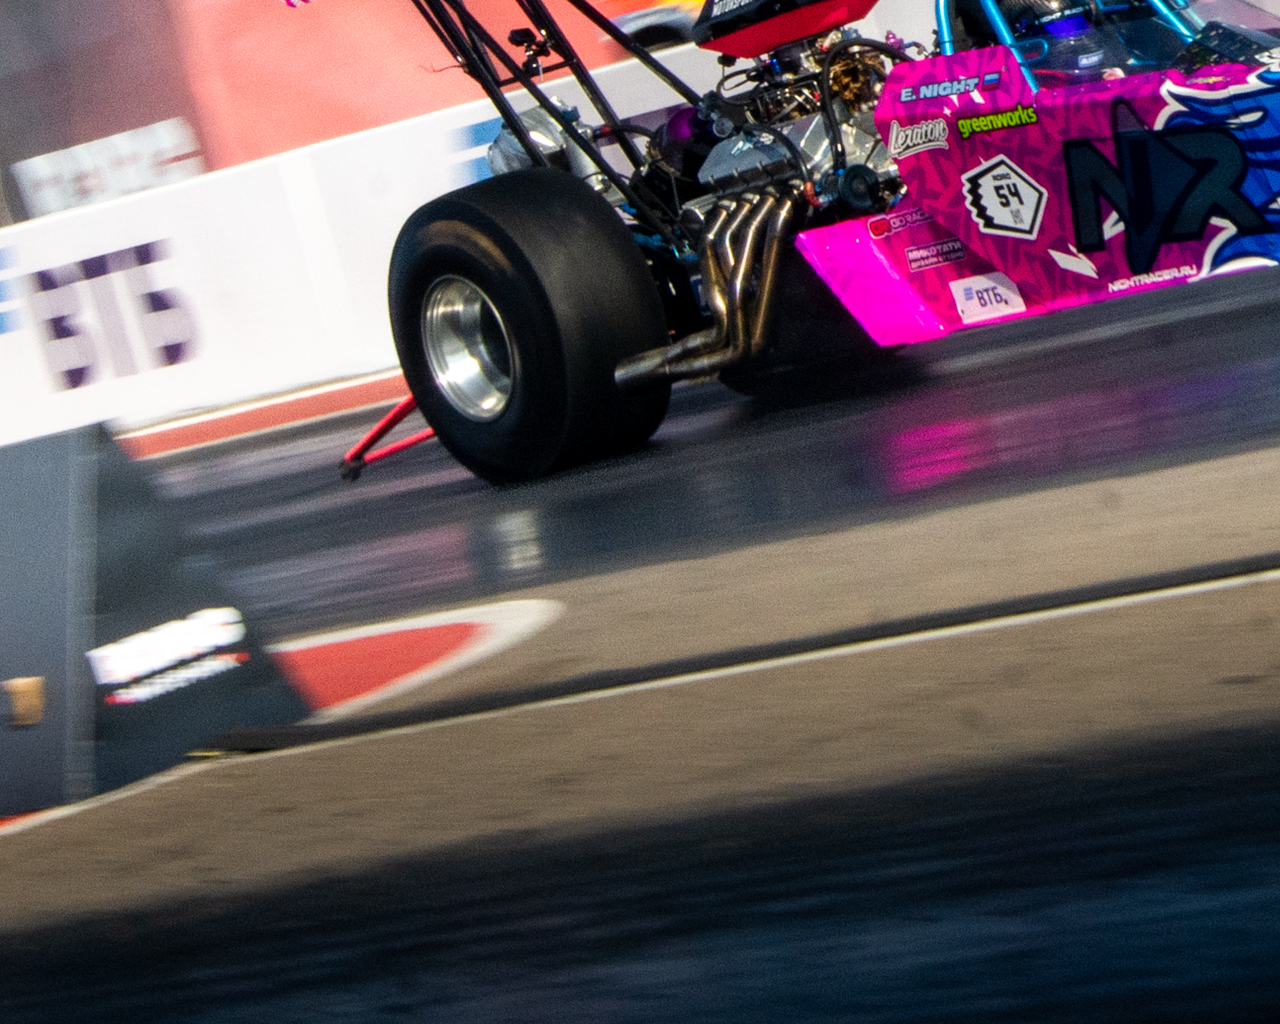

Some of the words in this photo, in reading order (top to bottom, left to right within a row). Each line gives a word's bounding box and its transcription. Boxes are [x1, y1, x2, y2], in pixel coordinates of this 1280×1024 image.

[901, 88, 916, 102] E.
[920, 78, 979, 99] NIGHT
[957, 104, 1038, 139] greenworks
[993, 183, 1024, 208] 54
[975, 287, 1004, 307] ВТБ
